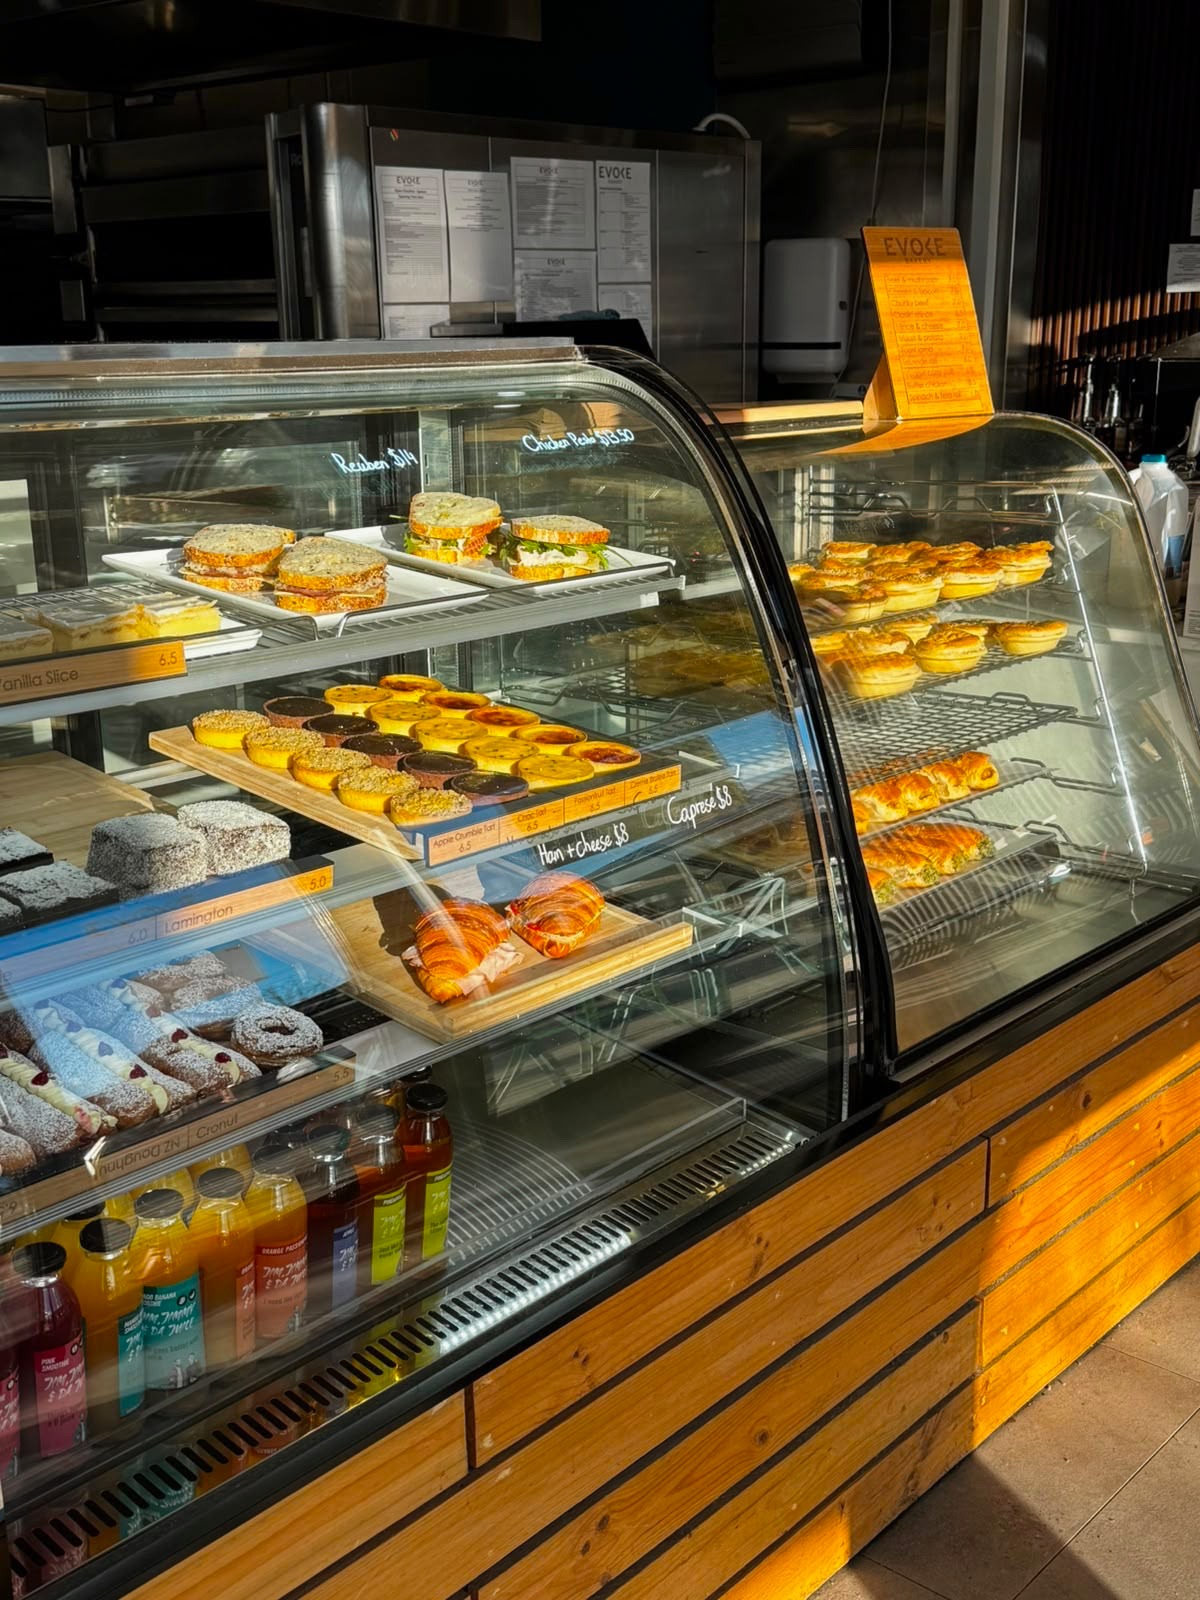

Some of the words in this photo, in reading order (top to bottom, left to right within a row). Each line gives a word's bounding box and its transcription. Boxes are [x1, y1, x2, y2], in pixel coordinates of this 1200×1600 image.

[396, 176, 421, 185] EVOKE
[598, 166, 632, 180] EVOKE
[883, 237, 946, 257] EVOKE
[522, 434, 570, 454] Chicken
[331, 452, 390, 474] Reuben
[386, 446, 419, 467] $14
[159, 651, 178, 666] 6.5
[46, 668, 79, 684] Slice
[666, 796, 717, 829] Caprese
[715, 785, 734, 808] $8
[517, 812, 534, 823] Choc
[433, 835, 454, 848] Apple
[455, 828, 482, 842] Crumble
[482, 823, 496, 834] Tart
[525, 823, 538, 833] 6.5
[458, 841, 471, 853] 6.5
[538, 844, 563, 866] Ham
[612, 822, 630, 848] $8
[309, 875, 328, 891] 5.0
[165, 903, 234, 935] Lamington
[128, 927, 148, 945] 6.0
[333, 1067, 351, 1083] 5.5
[196, 1113, 239, 1139] Cronut
[97, 1146, 161, 1176] Doughnu
[262, 1247, 284, 1255] ORANGE
[155, 1291, 176, 1300] BANANA
[41, 1357, 56, 1366] PINK
[41, 1358, 70, 1373] SMOOTHIE
